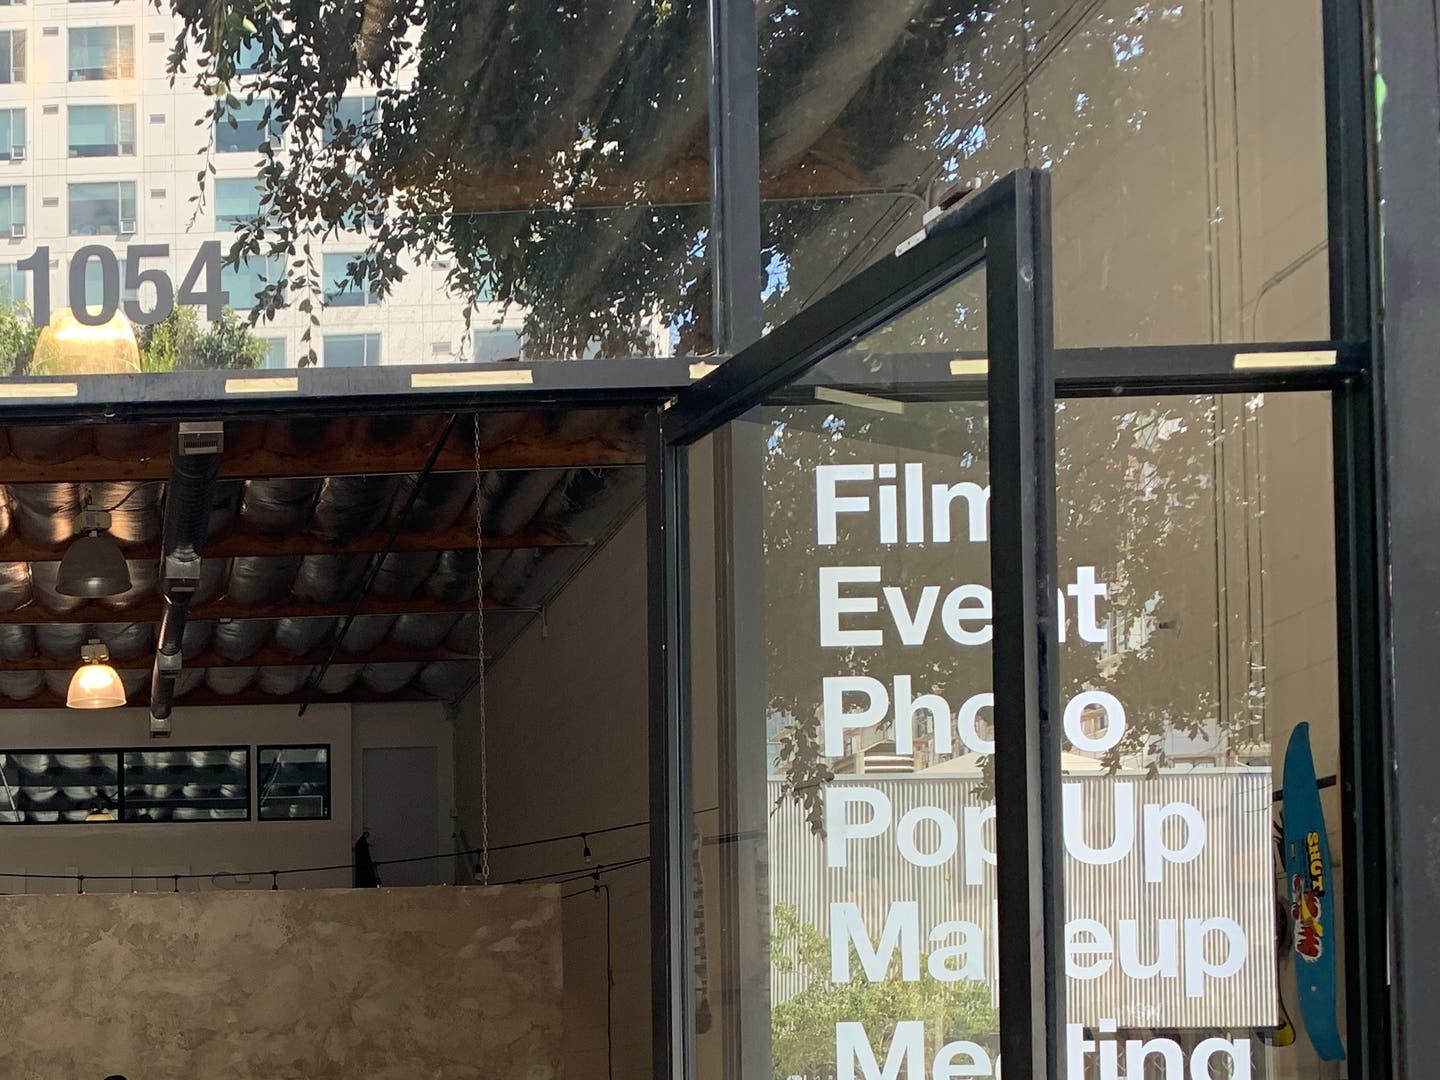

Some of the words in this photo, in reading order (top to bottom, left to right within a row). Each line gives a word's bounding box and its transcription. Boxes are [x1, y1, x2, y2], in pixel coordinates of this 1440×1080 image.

[17, 240, 230, 327] 1054
[819, 566, 1108, 647] Evet
[822, 675, 1126, 757] Phoo
[1063, 782, 1206, 882] Up
[830, 902, 1247, 997] Maeup
